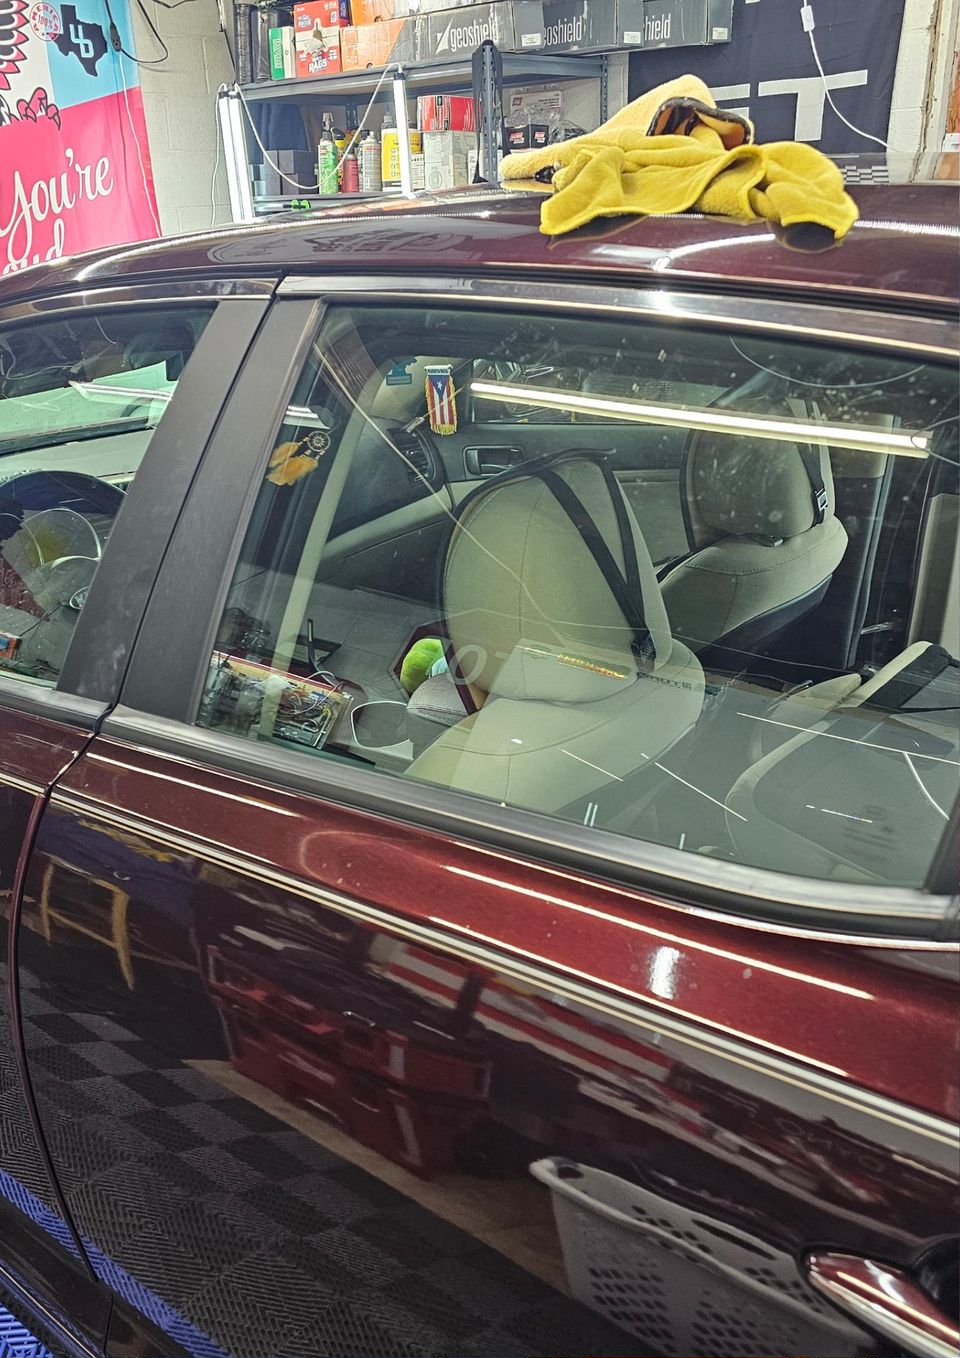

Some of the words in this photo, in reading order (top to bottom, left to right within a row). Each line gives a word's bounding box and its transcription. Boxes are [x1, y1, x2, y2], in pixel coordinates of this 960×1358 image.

[449, 16, 500, 52] geoshield
[542, 15, 583, 48] eoshield
[644, 13, 671, 41] hield
[308, 58, 328, 73] RAGS
[708, 69, 869, 142] T
